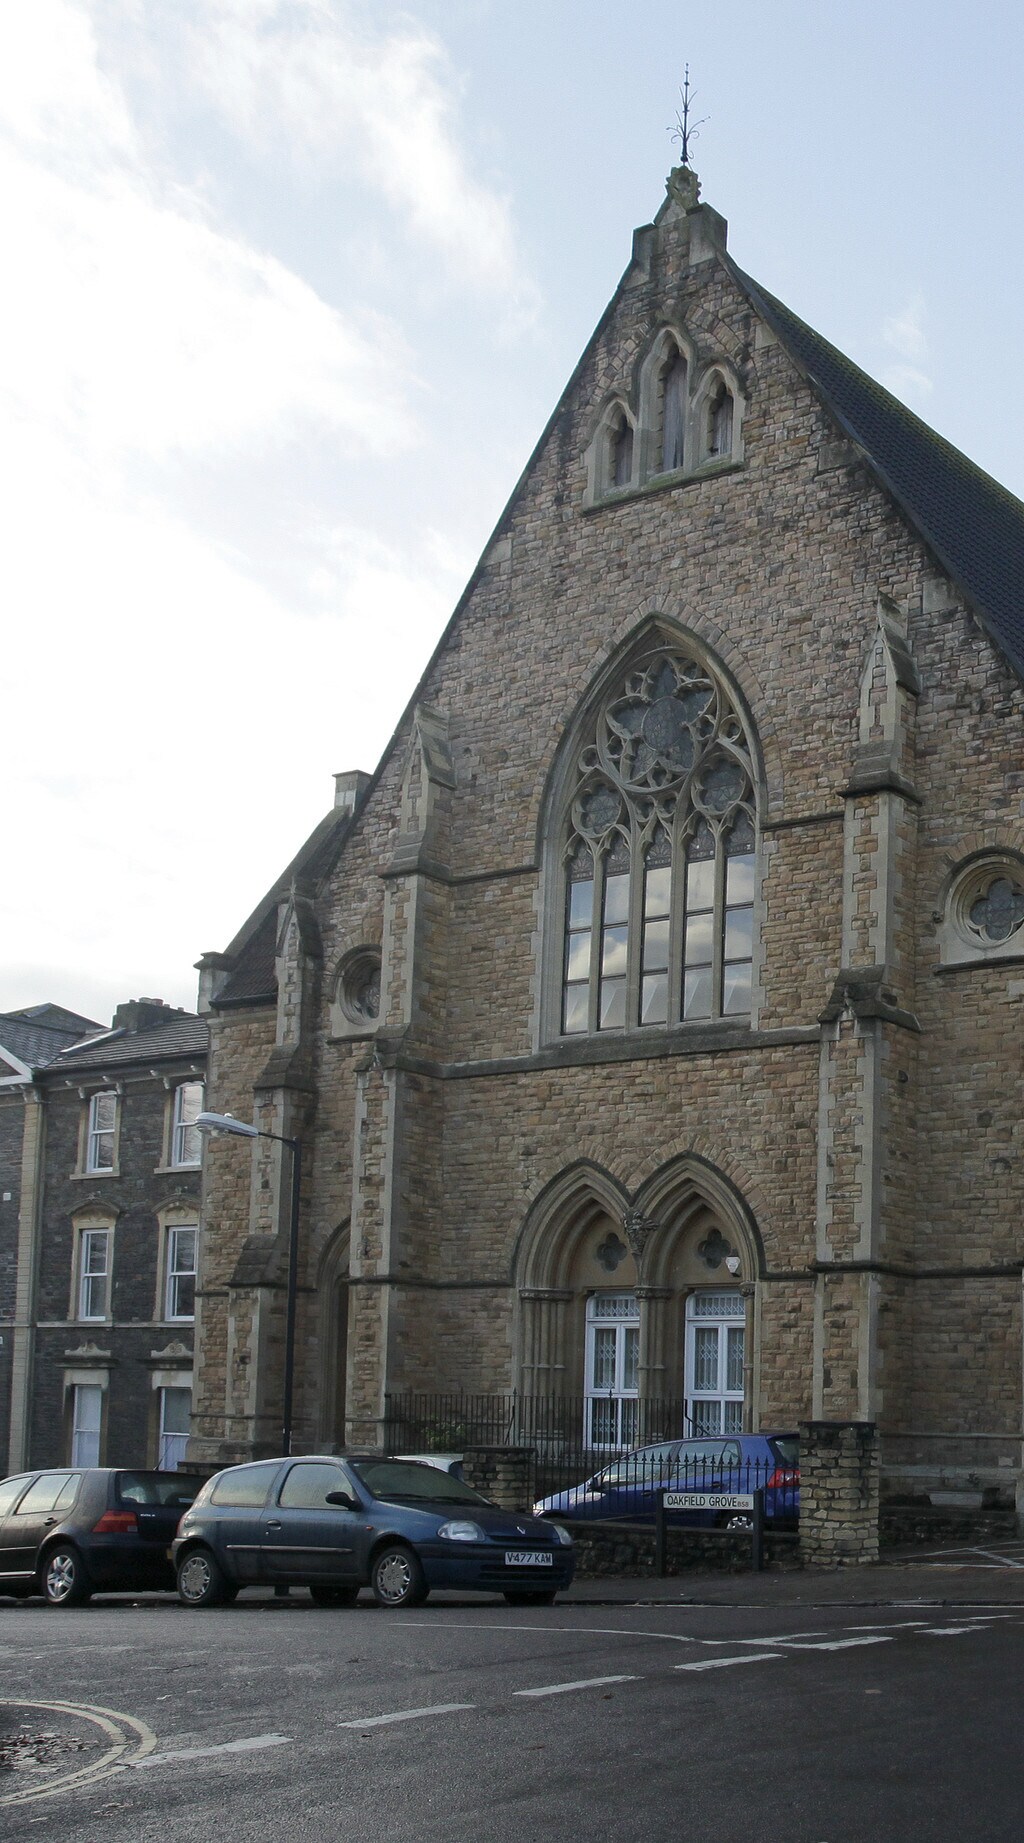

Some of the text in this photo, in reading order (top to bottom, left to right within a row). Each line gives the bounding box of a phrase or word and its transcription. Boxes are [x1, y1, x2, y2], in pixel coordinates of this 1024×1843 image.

[667, 1495, 706, 1506] OAKFIELD
[708, 1496, 737, 1507] GROVE
[506, 1552, 533, 1563] V477
